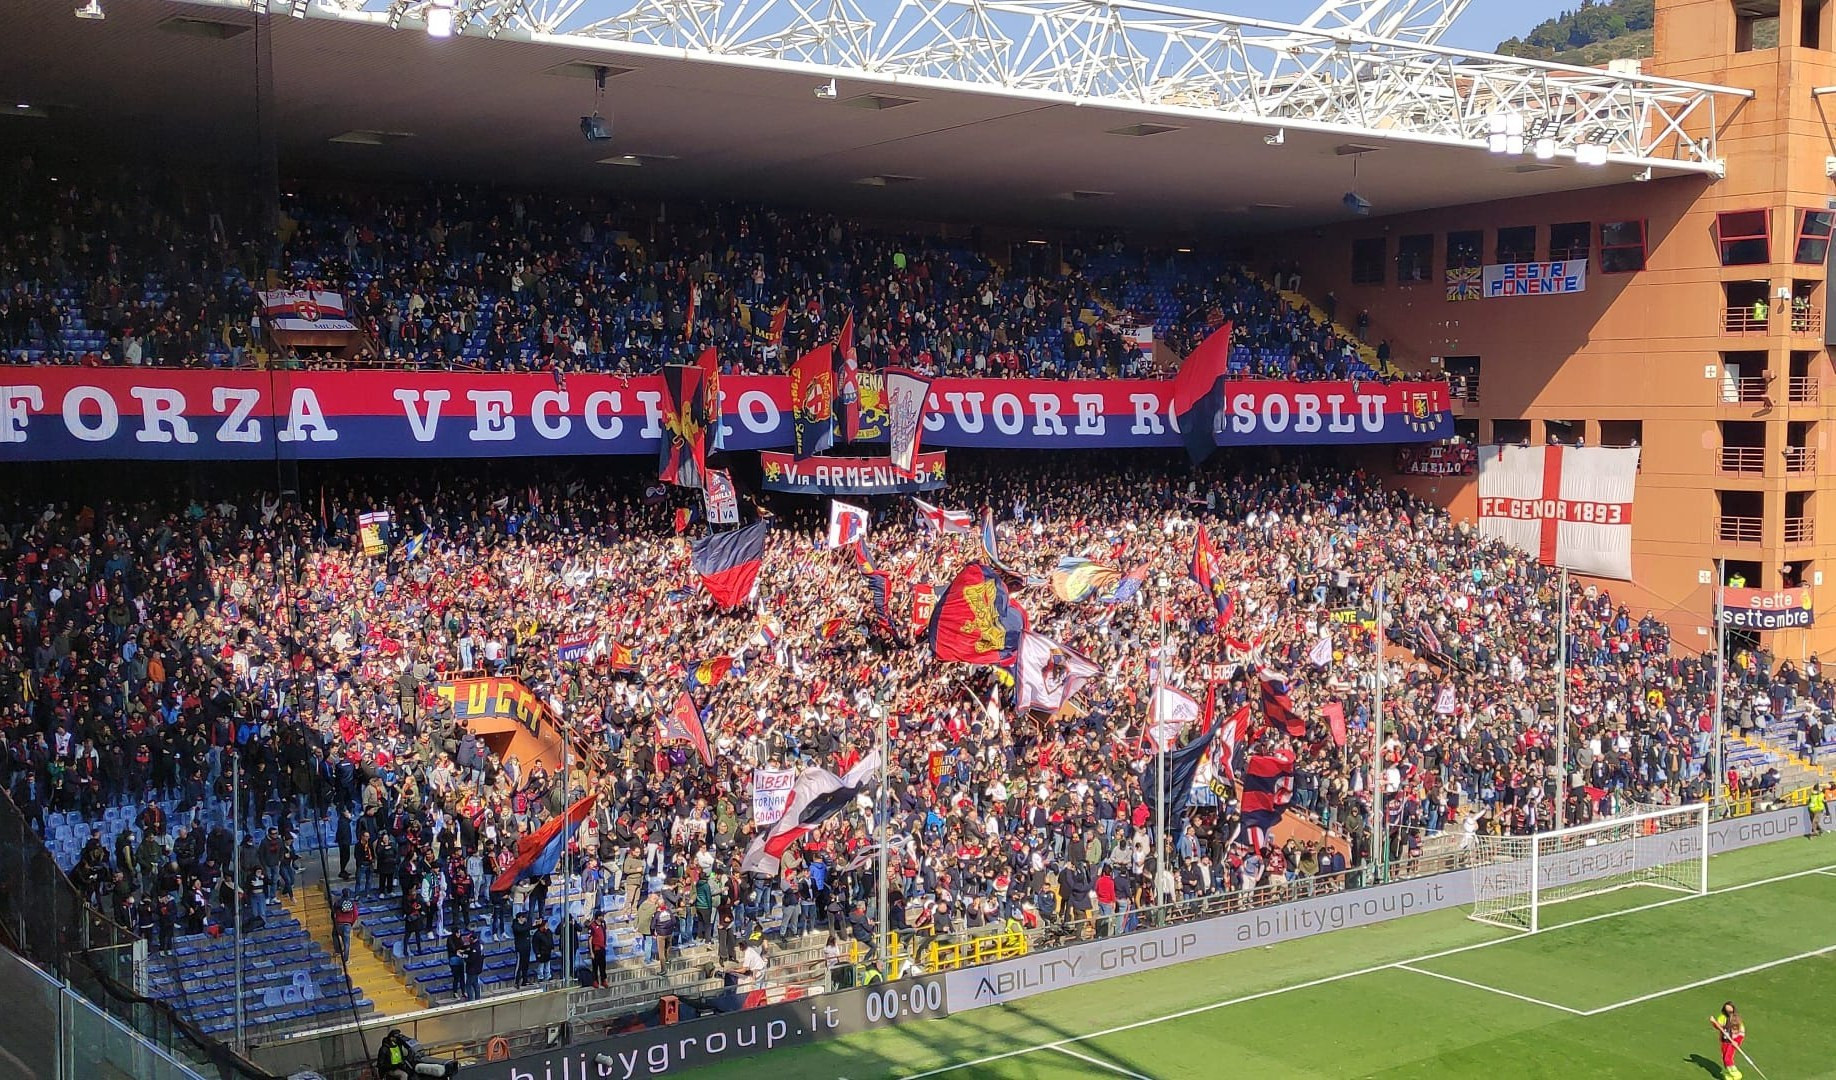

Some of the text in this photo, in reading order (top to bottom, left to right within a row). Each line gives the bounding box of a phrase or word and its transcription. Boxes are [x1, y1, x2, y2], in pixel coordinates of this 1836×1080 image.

[1504, 262, 1567, 279] SESTRI
[1492, 276, 1578, 296] PONENTE
[0, 385, 338, 443] FORZA
[1130, 393, 1388, 435] RSOBLU
[1411, 461, 1461, 473] ANELLO
[1482, 498, 1622, 523] F.C. GENOA 1893
[1751, 592, 1793, 609] sette
[1723, 609, 1809, 628] settembre
[1739, 815, 1798, 842] GROUP
[975, 881, 1445, 1000] ABILITY GROUP abilitygroup.it
[866, 980, 942, 1023] 00:00
